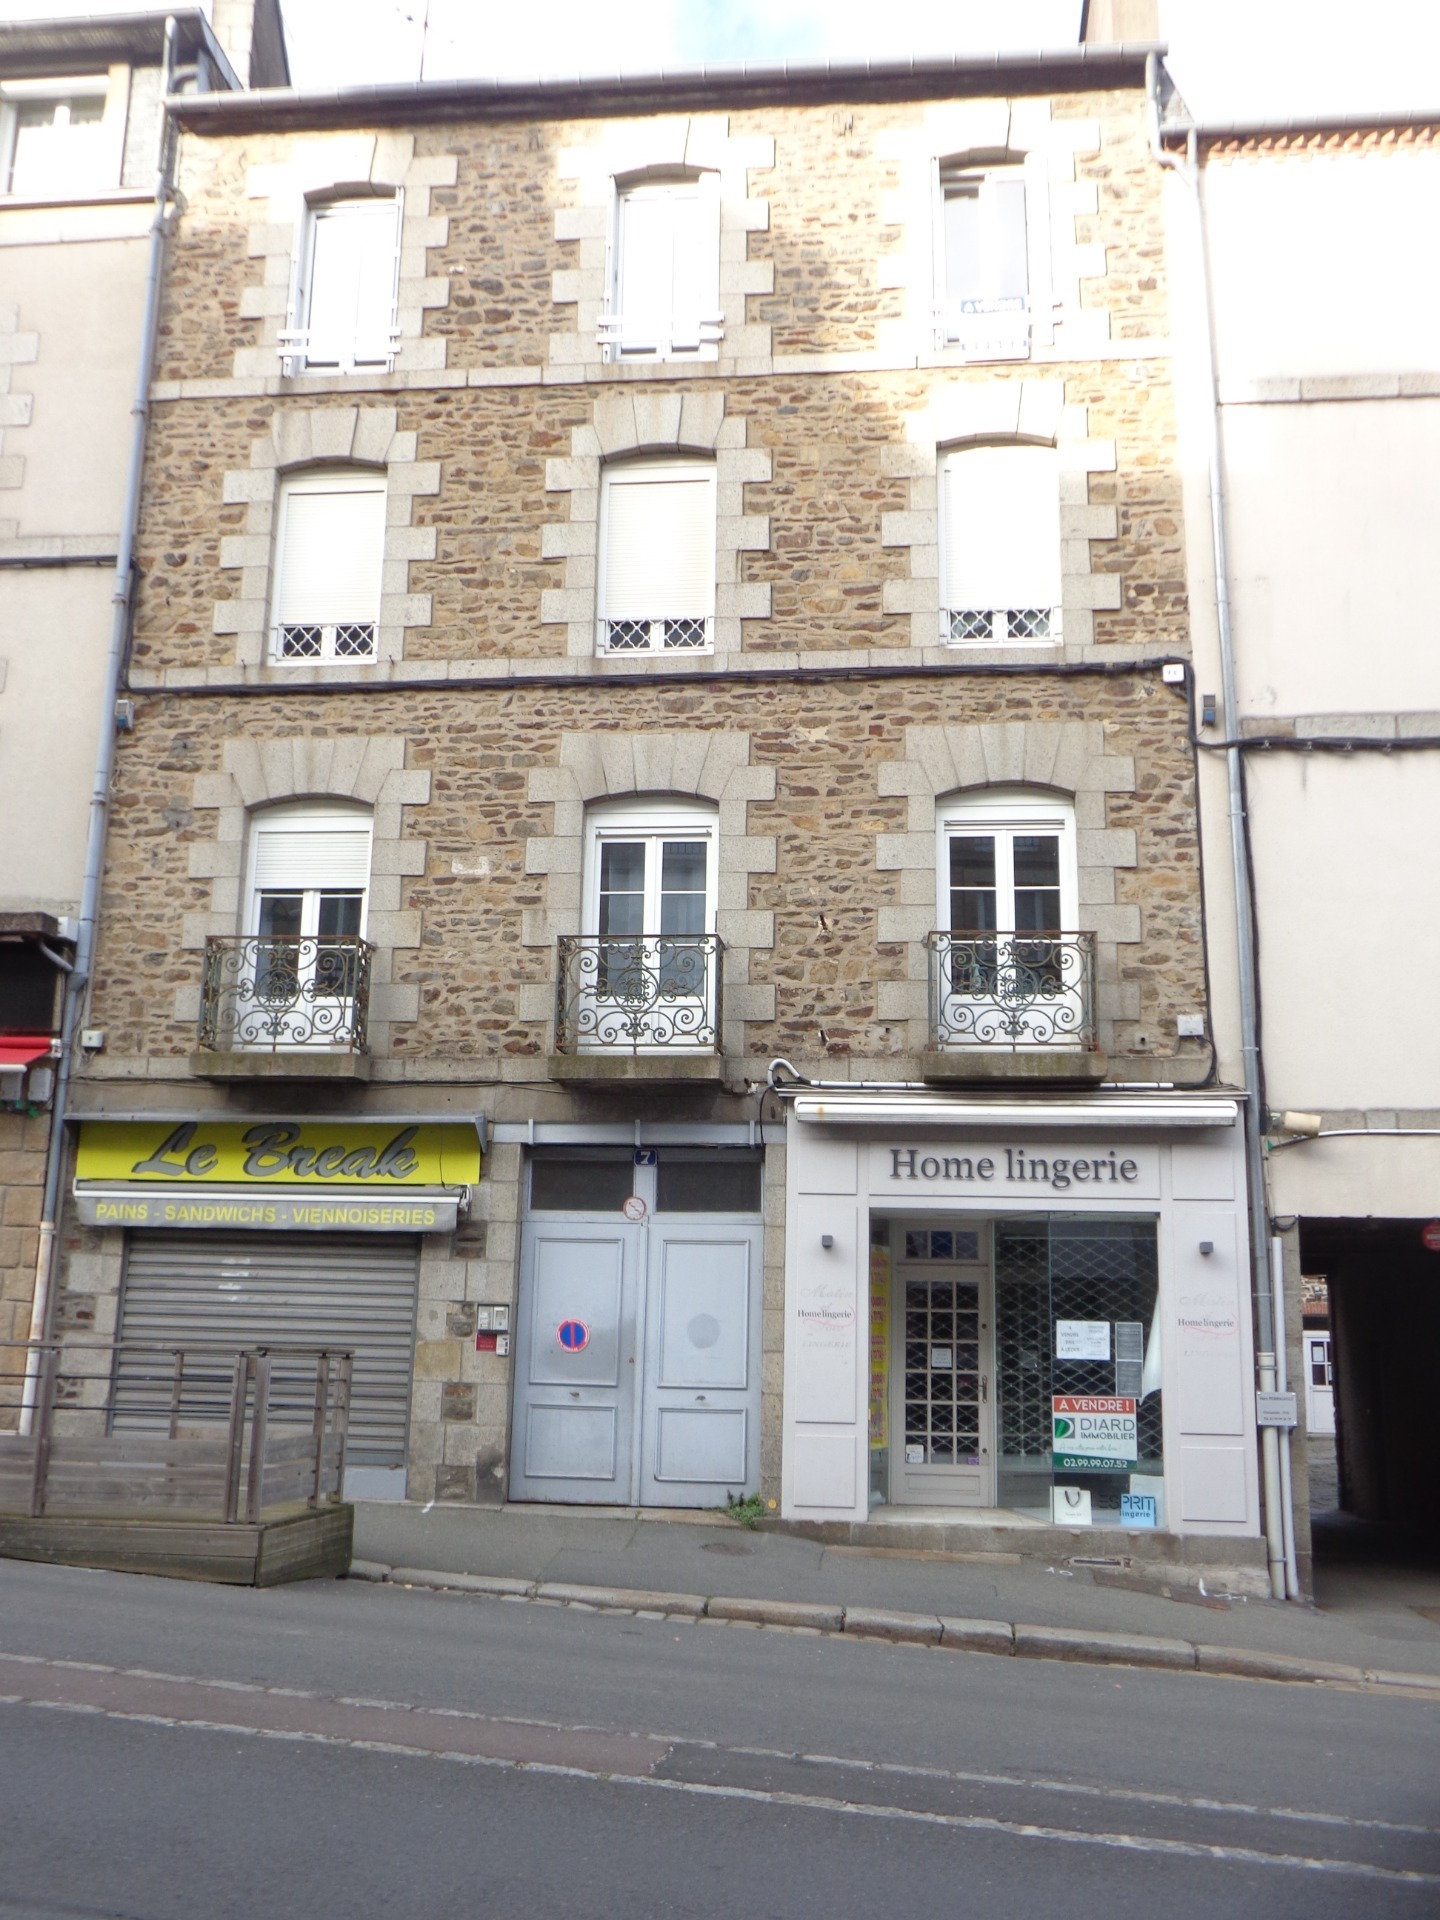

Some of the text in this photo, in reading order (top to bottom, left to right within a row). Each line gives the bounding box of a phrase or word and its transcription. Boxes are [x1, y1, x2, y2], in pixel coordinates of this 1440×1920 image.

[131, 1121, 419, 1179] Le Break
[640, 1151, 651, 1165] 7
[889, 1149, 1138, 1189] Home lingerie
[96, 1204, 148, 1220] PAINS
[164, 1205, 276, 1223] SANDWICHS
[293, 1207, 435, 1225] VIENNOISERIES
[1059, 1399, 1069, 1410] A
[1072, 1399, 1123, 1412] VENDRE
[1080, 1418, 1135, 1432] DIARD
[1080, 1432, 1135, 1440] IMMOBILIER
[1063, 1458, 1128, 1469] 02.99.99.07.52
